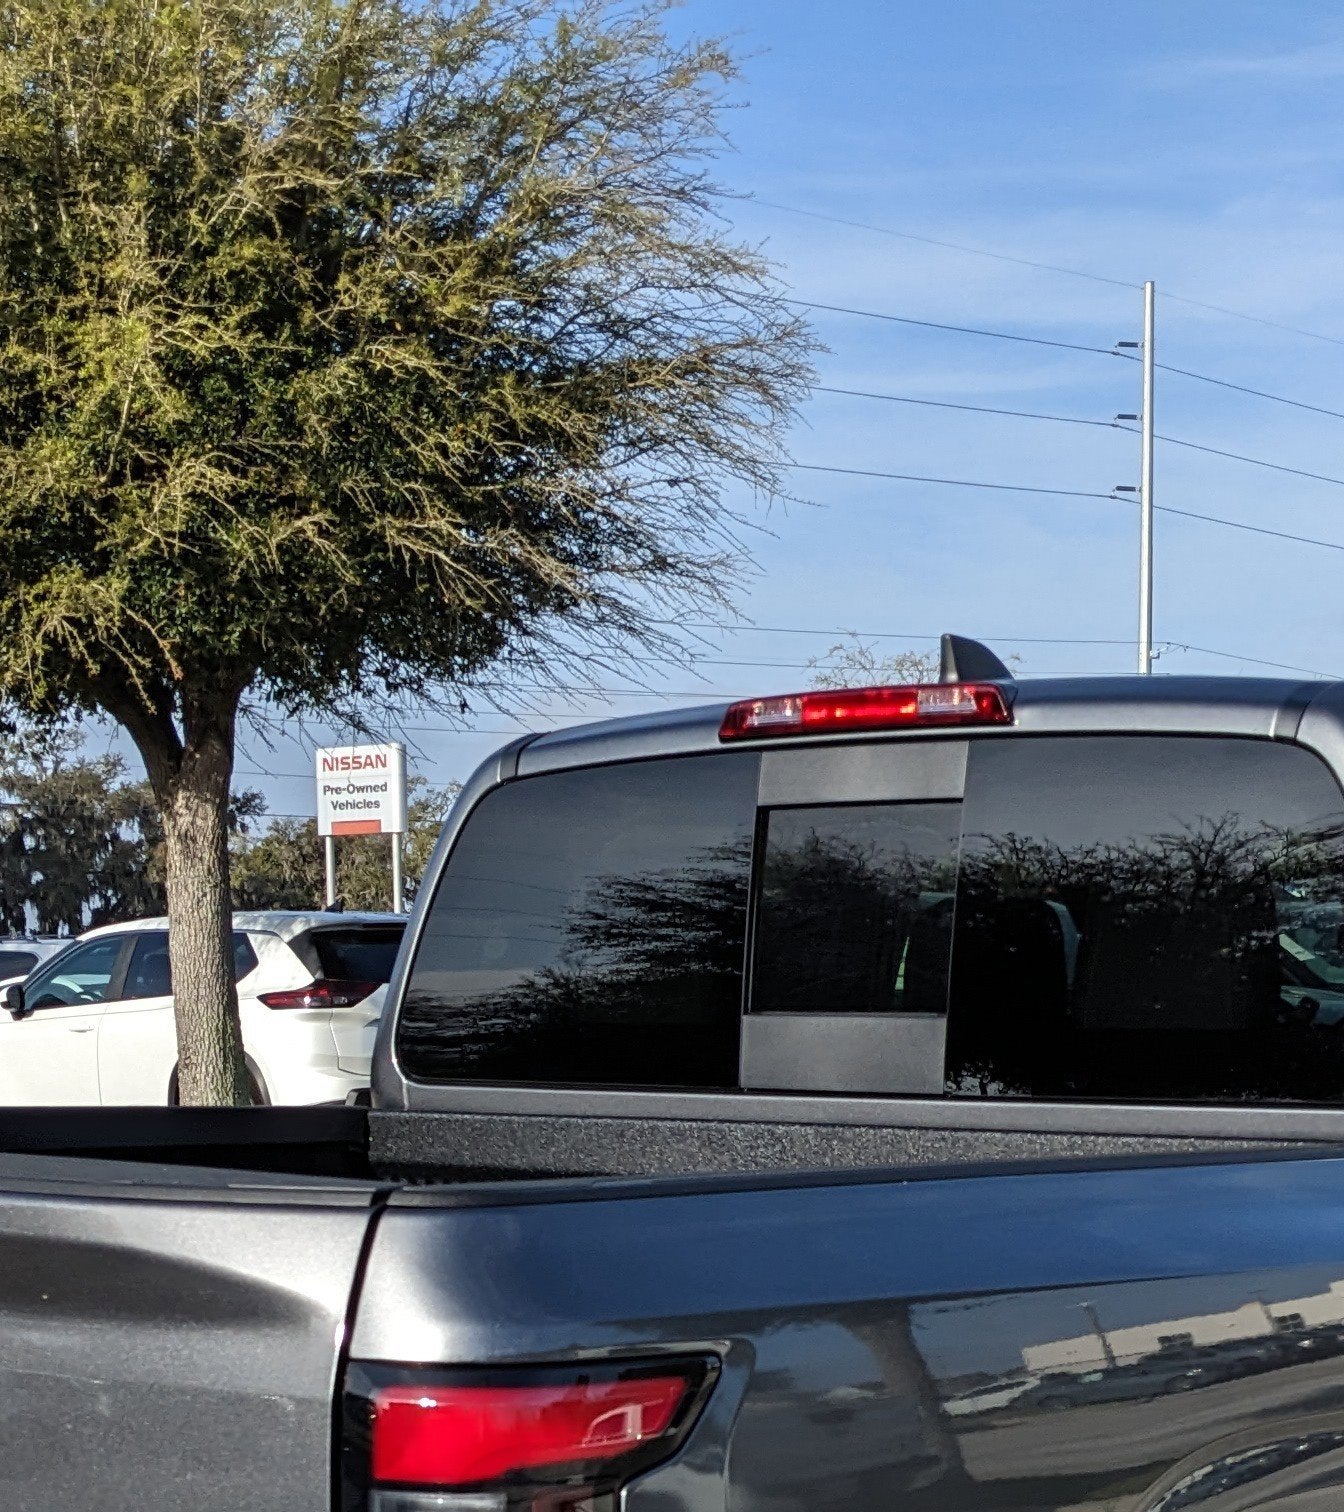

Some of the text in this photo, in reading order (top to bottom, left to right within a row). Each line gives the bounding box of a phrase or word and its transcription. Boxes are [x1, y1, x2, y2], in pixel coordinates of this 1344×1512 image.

[322, 754, 387, 772] NISSAN
[323, 781, 388, 796] Pre-Owned
[331, 799, 381, 811] Vehicles
